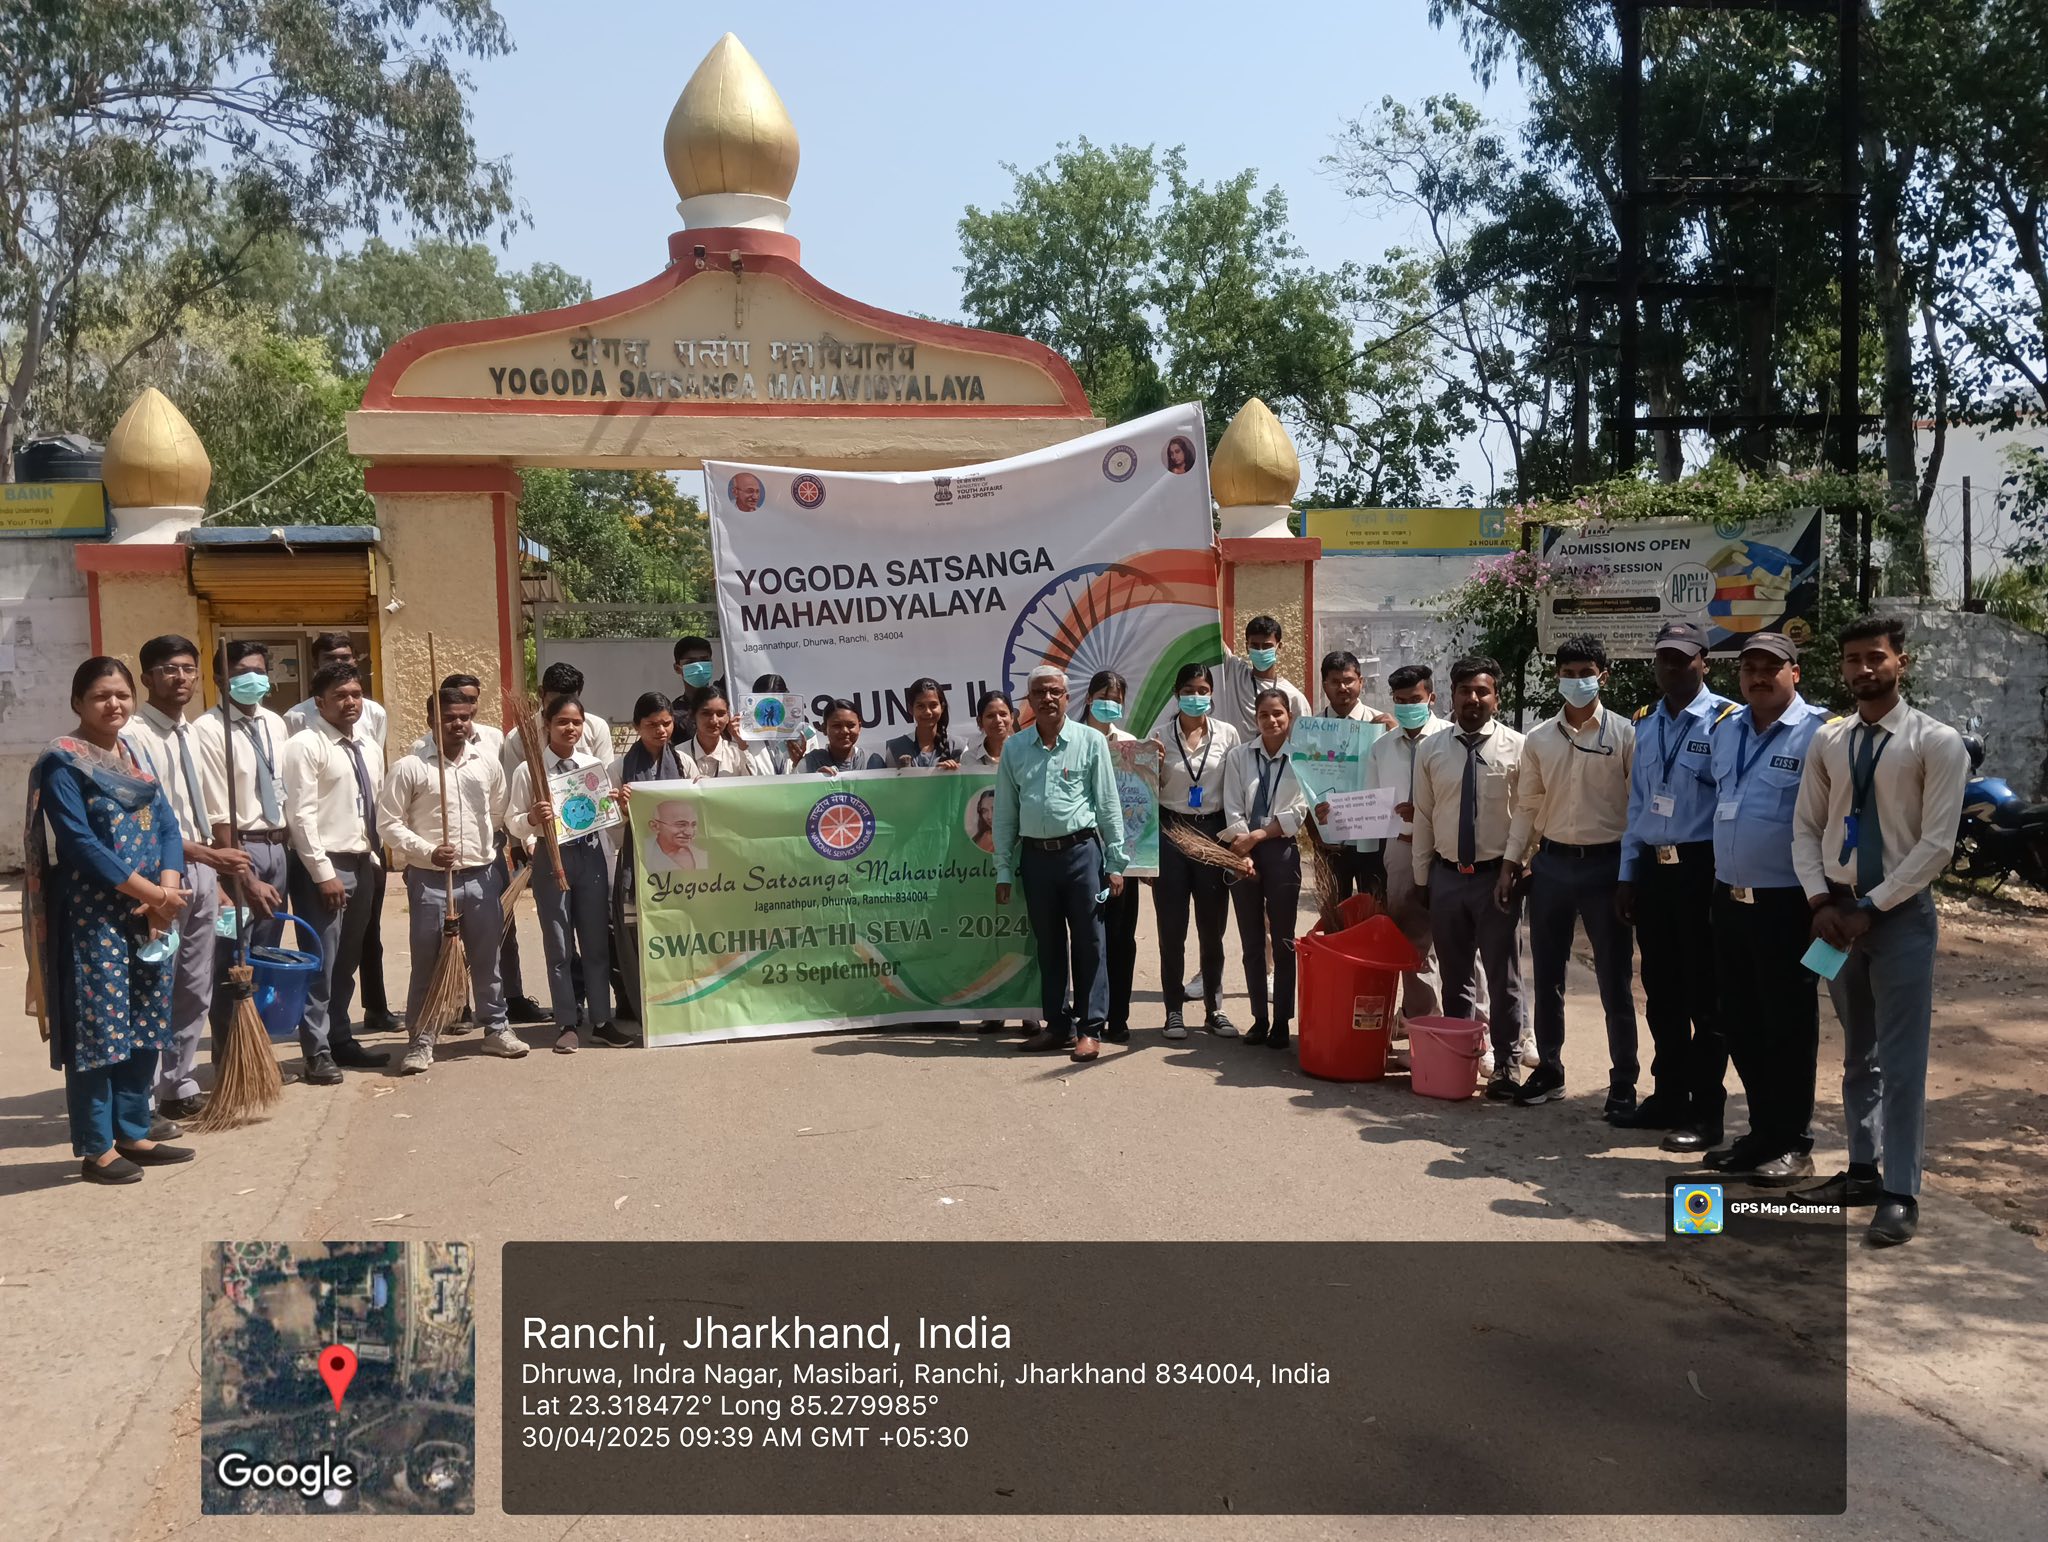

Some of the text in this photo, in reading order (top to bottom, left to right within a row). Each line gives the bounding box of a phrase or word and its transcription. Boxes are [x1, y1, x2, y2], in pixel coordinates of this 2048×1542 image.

[488, 367, 985, 401] YOGODA SATSANGA MAHAVIDYALAYA
[5, 487, 54, 500] BANK
[1559, 538, 1692, 556] ADMISSIONS OPEN
[735, 547, 1055, 596] YOGODA SATSANGA
[1613, 562, 1663, 574] SESSION
[741, 586, 1007, 632] MAHAVIDYALAYA
[743, 641, 801, 653] Jagannathpur,
[803, 637, 836, 647] Dhurwa,
[873, 631, 904, 641] 834004
[853, 684, 952, 729] UN
[1690, 743, 1709, 753] CISS
[1773, 758, 1795, 769] CISS
[811, 829, 872, 857] NATIONAL SERVICE SCHEME
[647, 859, 1023, 902] Yogoda Satsanga Mahavidyalaa
[754, 891, 929, 914] Jagannathpur, Dhurwa, Ranchi-834004
[648, 926, 819, 960] SWACHHATA
[828, 923, 857, 946] HI
[867, 919, 933, 944] SEVA
[958, 915, 1030, 938] 2024
[762, 958, 902, 985] 23 September
